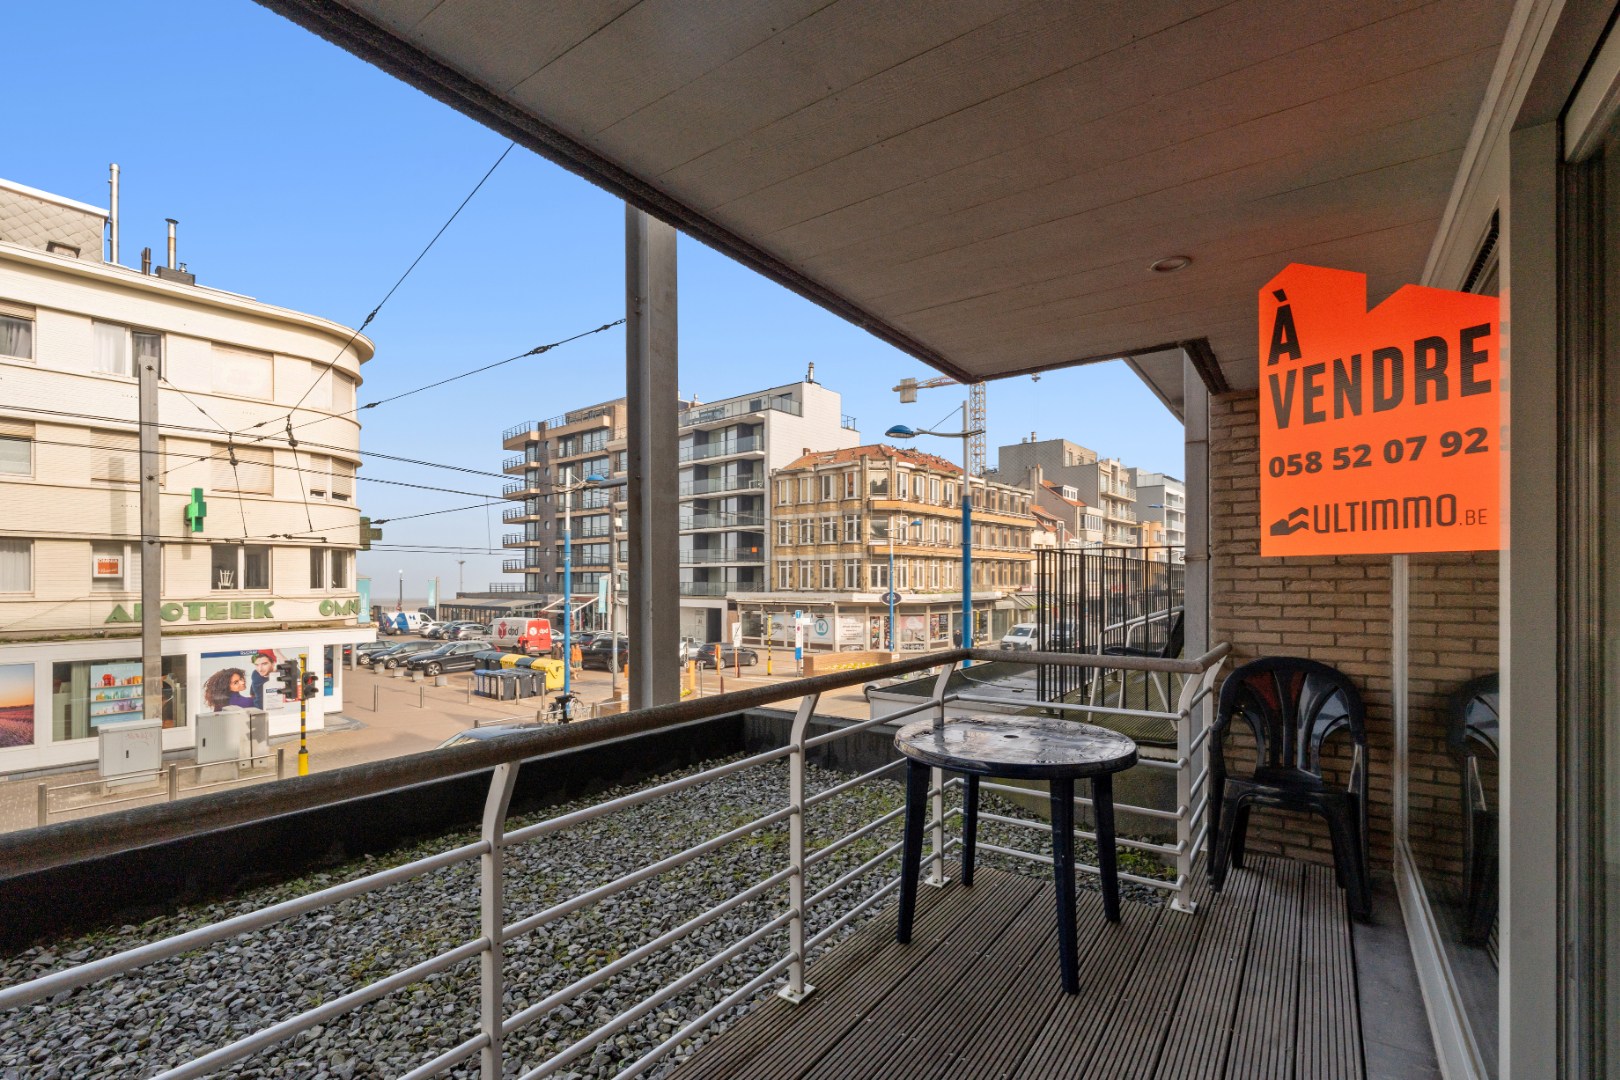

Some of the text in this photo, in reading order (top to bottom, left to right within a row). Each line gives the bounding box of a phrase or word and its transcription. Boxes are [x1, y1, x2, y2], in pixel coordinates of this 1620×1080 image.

[1267, 288, 1302, 367] À
[1268, 322, 1492, 430] VENDRE
[1268, 426, 1489, 478] 058 52 07 92
[508, 626, 519, 636] dpd
